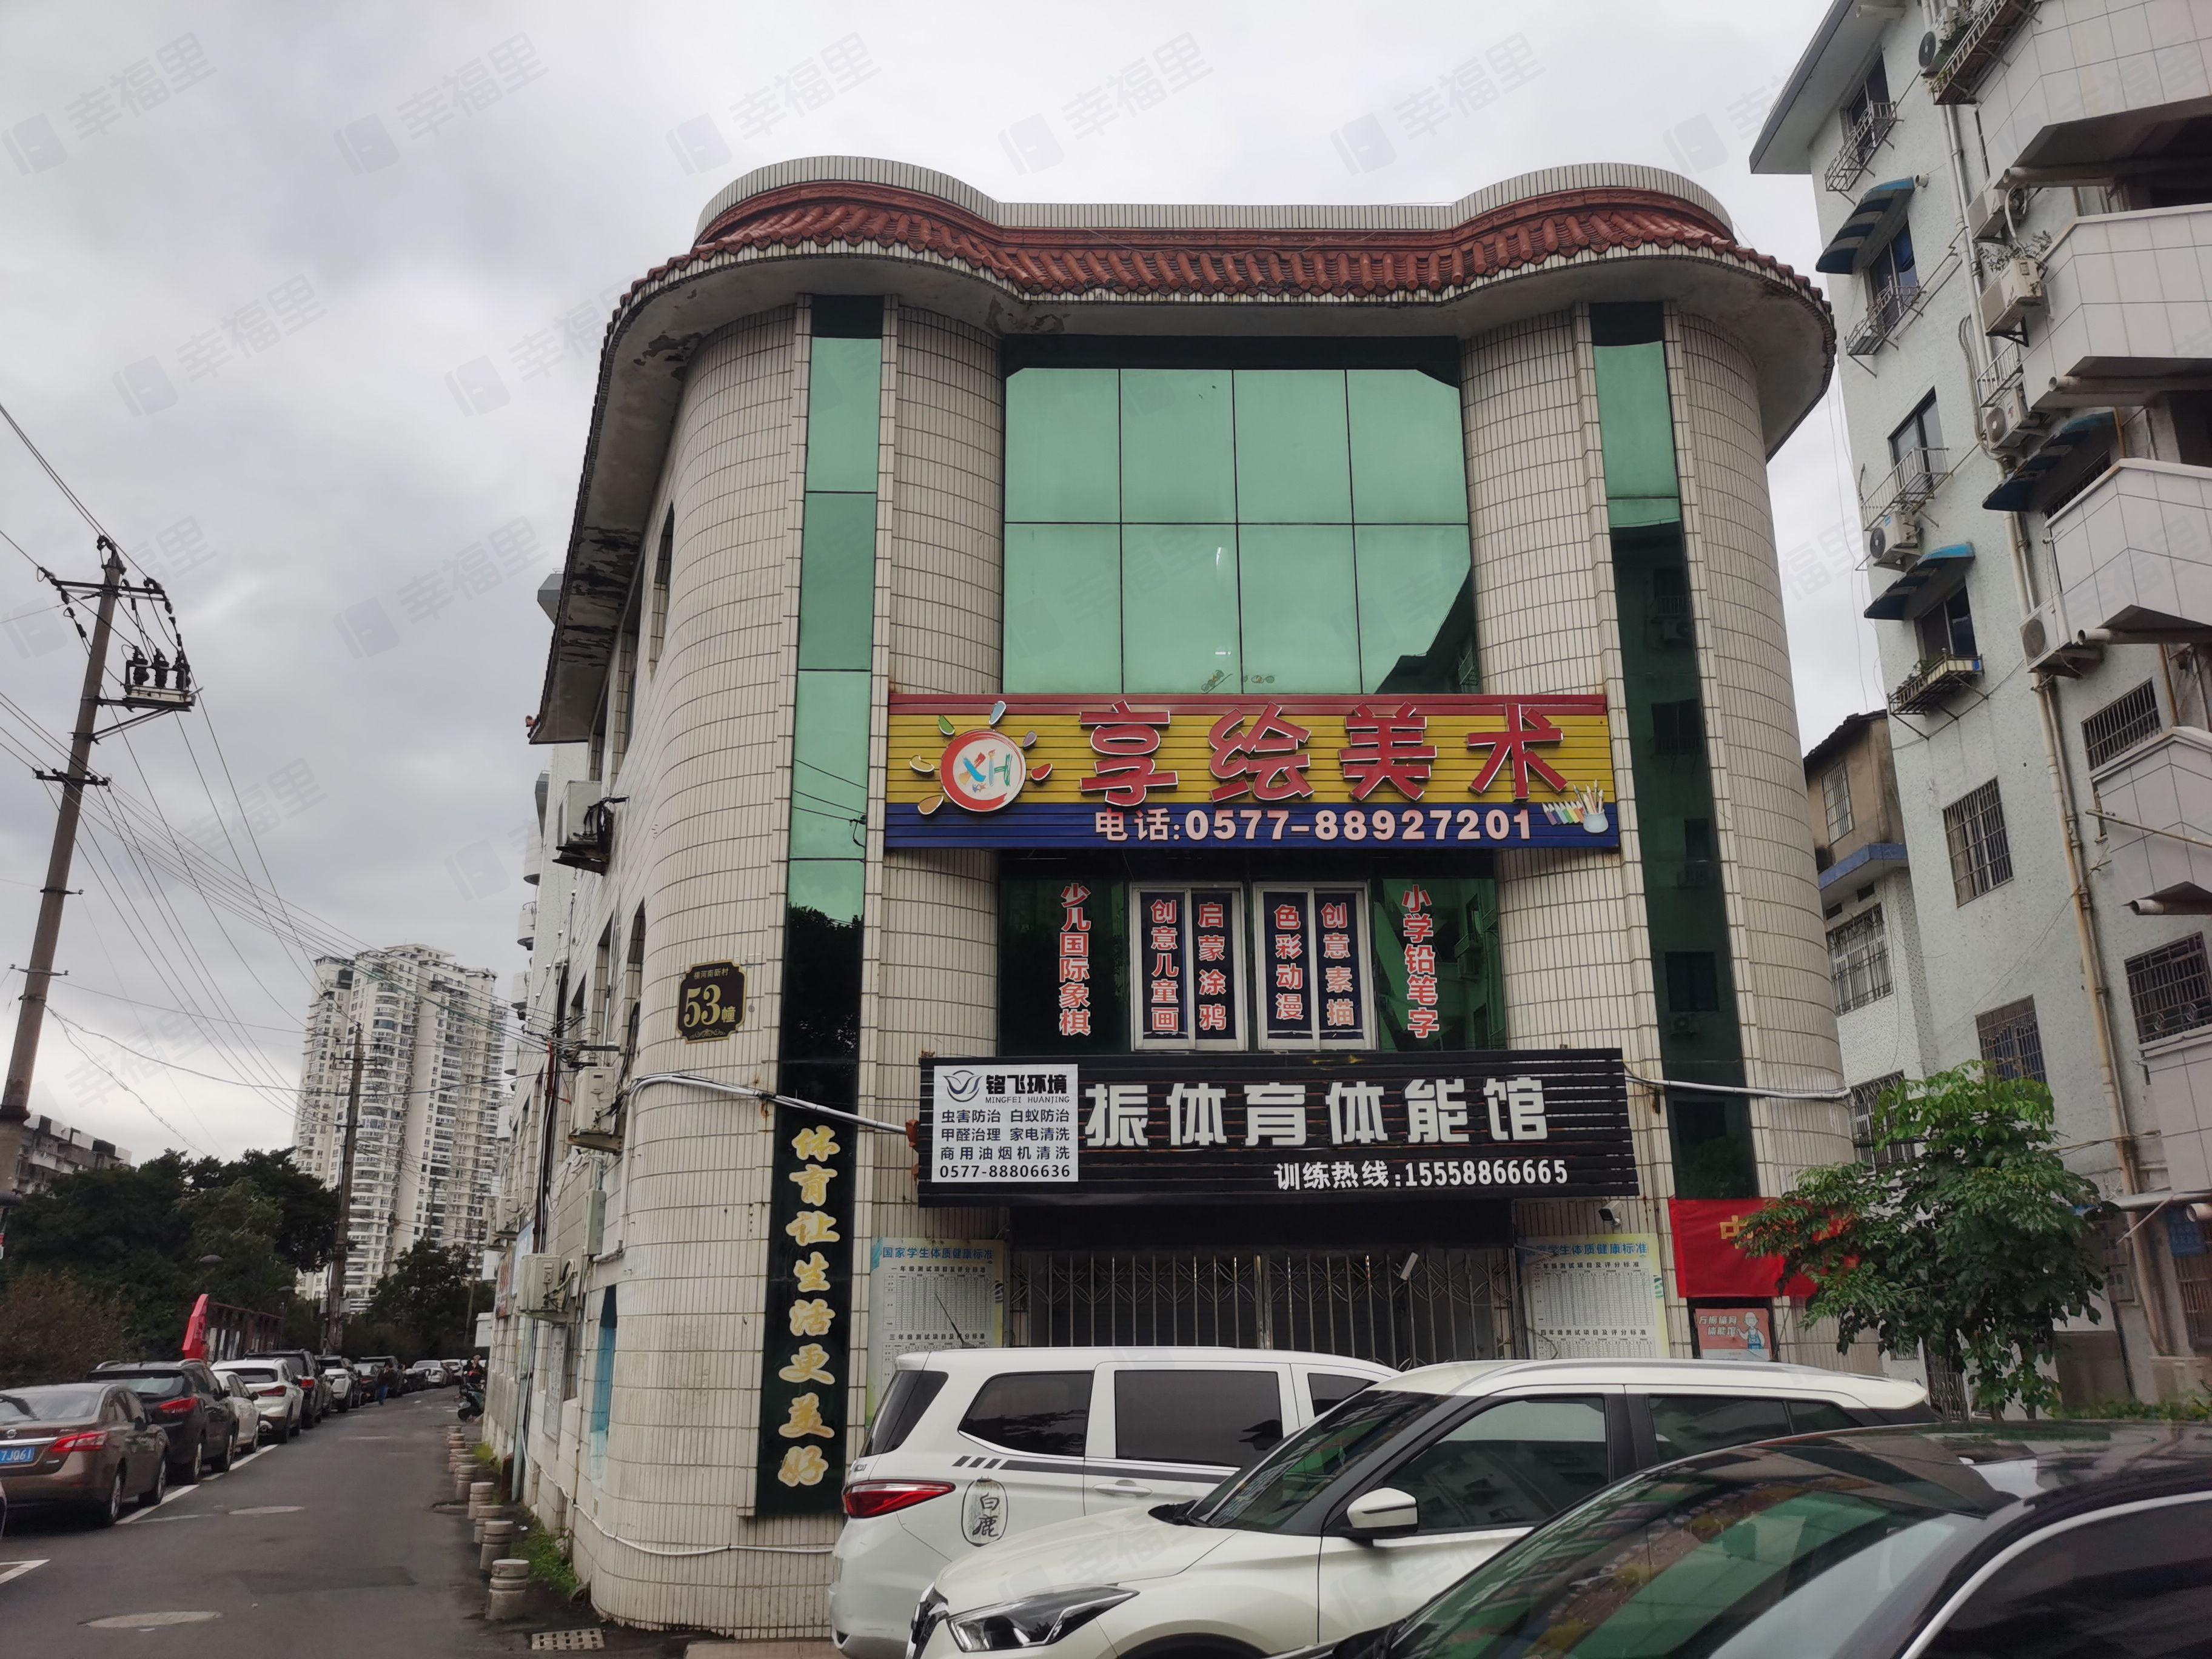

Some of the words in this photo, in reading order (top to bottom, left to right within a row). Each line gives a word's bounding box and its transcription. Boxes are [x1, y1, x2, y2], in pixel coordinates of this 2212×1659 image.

[1079, 699, 1569, 806] 享绘美术
[1058, 882, 1091, 1037] 少儿国际象棋
[1150, 899, 1179, 1032] 创意儿童画
[1198, 900, 1227, 1032] 启蒙涂鸦
[1273, 903, 1304, 1022] 色彩动漫
[1320, 902, 1355, 1027] 创意素描
[1401, 884, 1440, 1039] 小学铅笔字
[941, 1109, 1000, 1123] 虫害防治
[1010, 1108, 1069, 1123] 白蚁防治
[986, 1074, 1067, 1094] 铭飞环境
[1027, 1096, 1070, 1104] HUANJING
[1085, 1077, 1552, 1149] 振体育体能馆
[940, 1145, 1070, 1161] 商用油烟机清洗
[941, 1128, 1000, 1142] 甲醛治理
[1010, 1127, 1070, 1141] 家电清洗
[940, 1164, 1070, 1178] 0577-88806636
[882, 1247, 994, 1259] 国家学生体质健康标准
[1526, 1242, 1648, 1256] 学生体质健康标准
[777, 1124, 841, 1487] 体育让生活更美好
